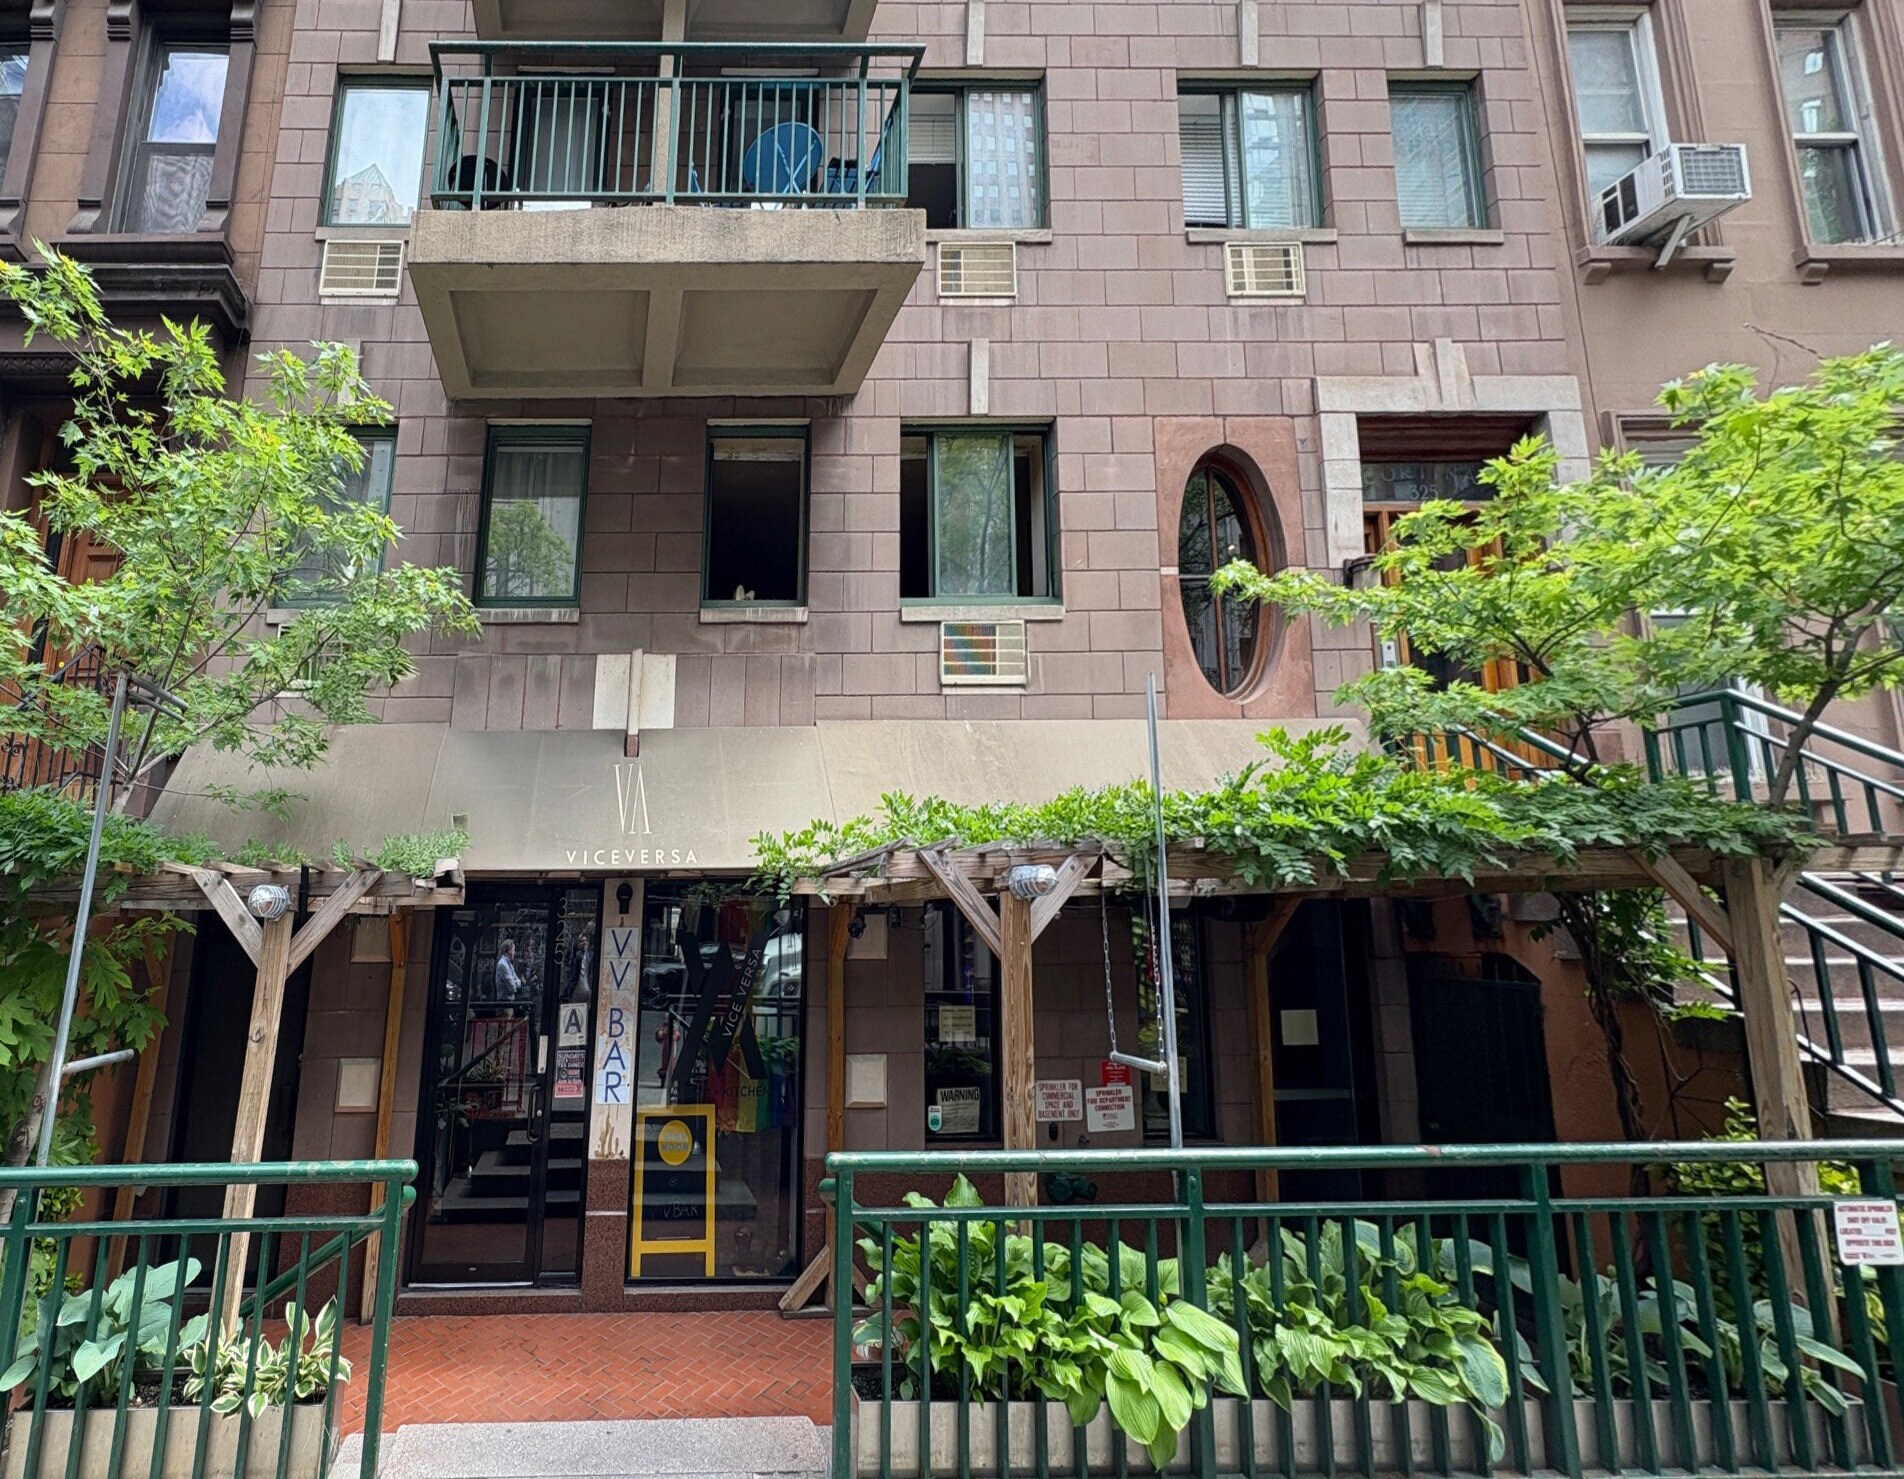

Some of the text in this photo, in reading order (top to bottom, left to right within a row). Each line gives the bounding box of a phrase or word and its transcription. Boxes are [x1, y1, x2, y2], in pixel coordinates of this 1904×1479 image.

[1409, 484, 1439, 500] 325
[566, 850, 698, 866] VICEVERSA
[553, 897, 568, 965] 325
[722, 949, 763, 1037] VICE VERSA
[564, 1008, 582, 1034] A
[602, 1008, 626, 1103] BAR
[1039, 1082, 1078, 1091] SPRINKLER FOR
[940, 1088, 979, 1102] WARNING
[1045, 1100, 1074, 1109] SPACE AND
[661, 1142, 689, 1152] NOON
